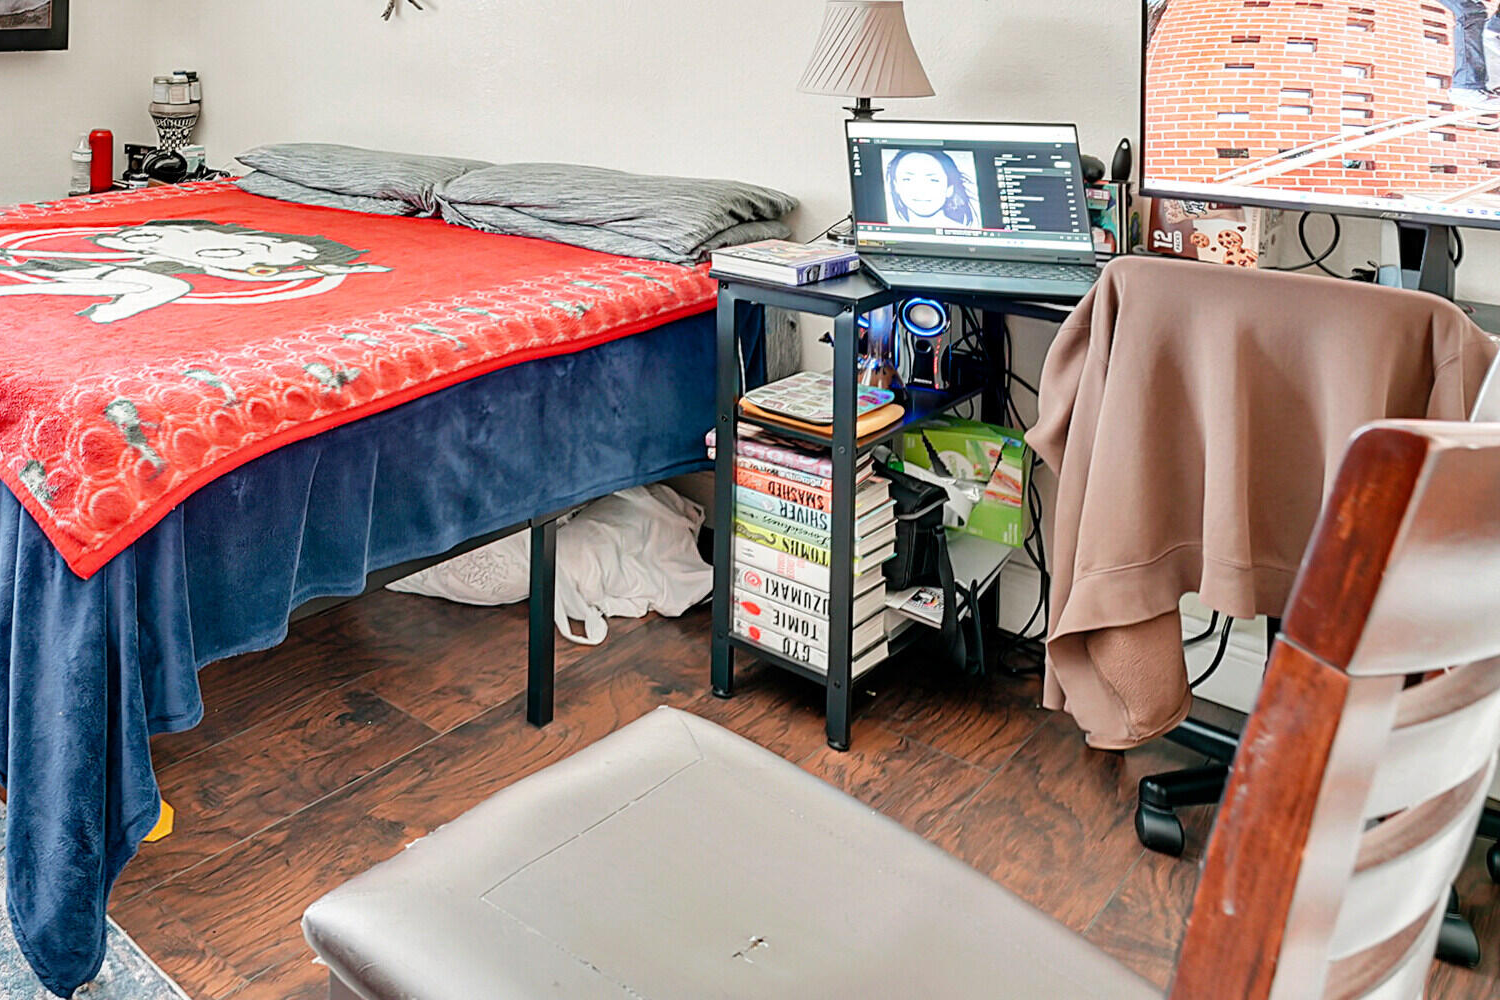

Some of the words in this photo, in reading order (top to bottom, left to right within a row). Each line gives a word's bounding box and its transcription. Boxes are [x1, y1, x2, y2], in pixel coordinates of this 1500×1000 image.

[1153, 230, 1173, 249] 12
[768, 480, 824, 510] SMASHED
[779, 501, 828, 530] SHIVER
[782, 538, 829, 568] TOMBS
[773, 609, 819, 641] TOMIE
[783, 637, 811, 662] GYO
